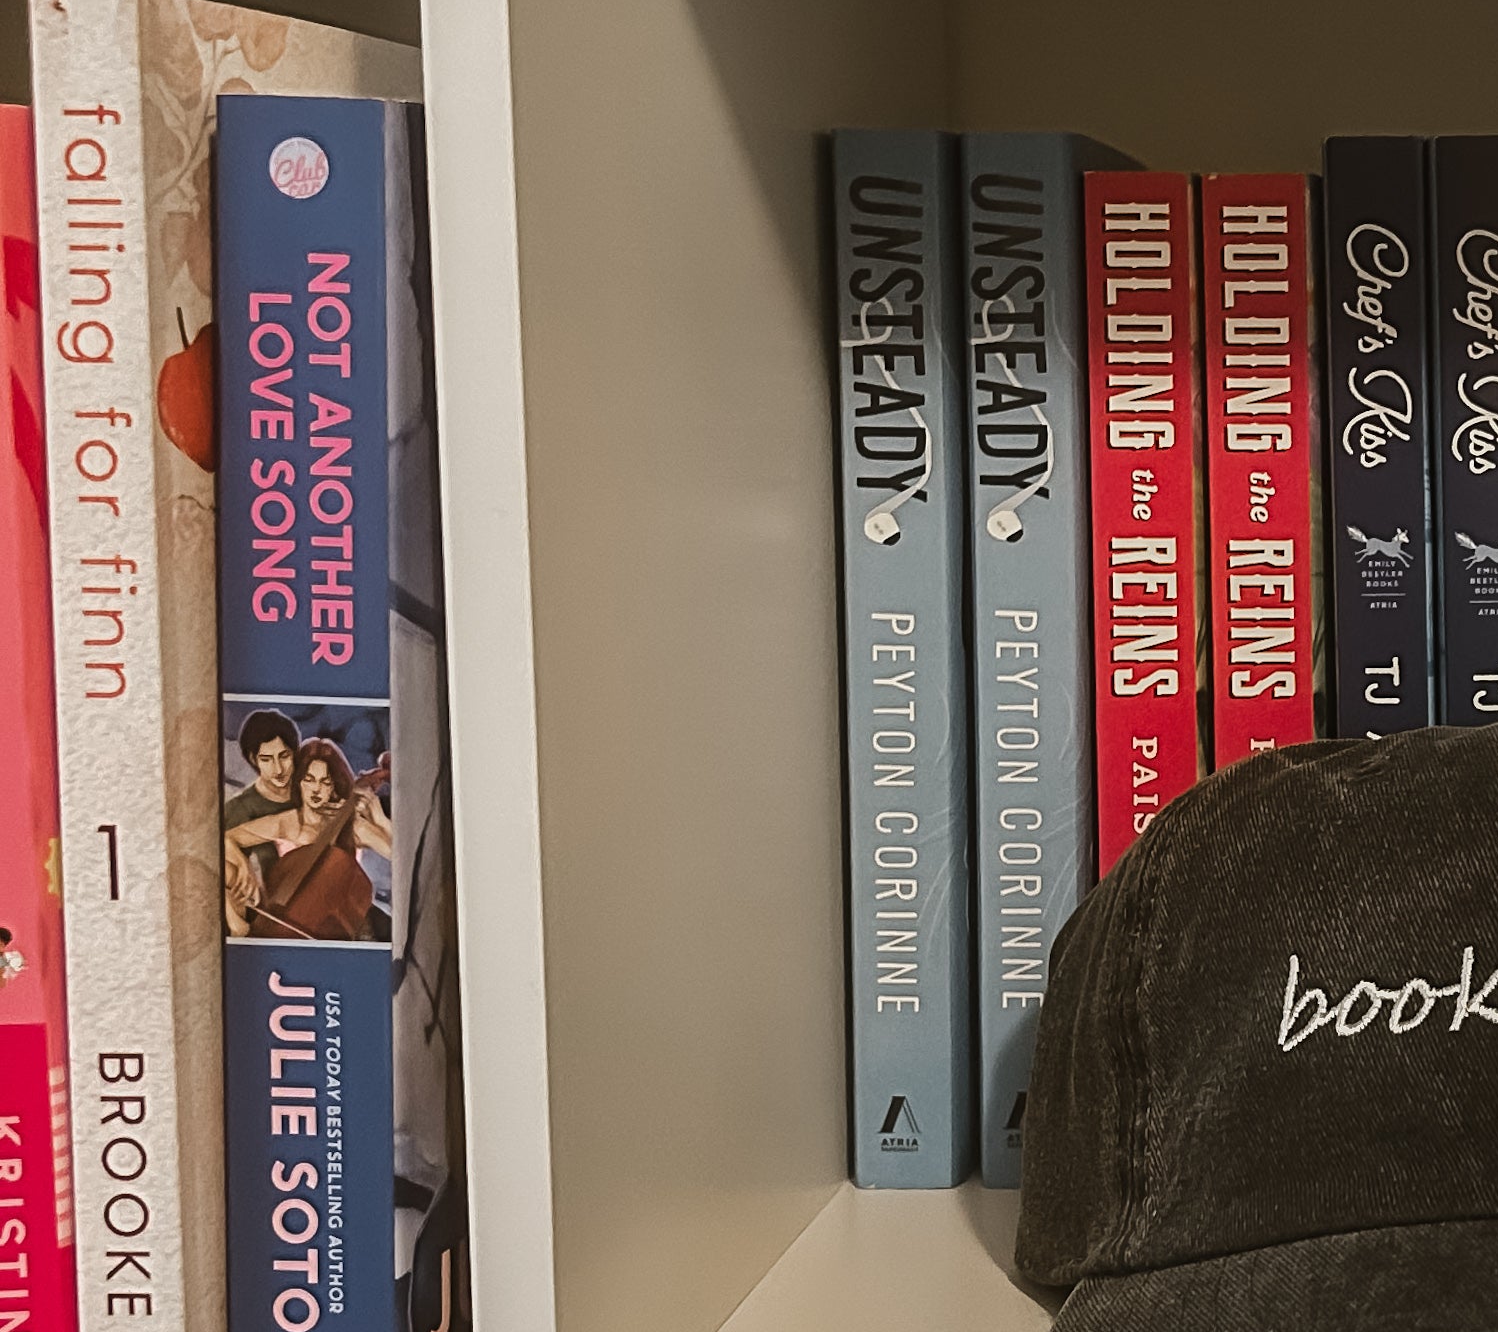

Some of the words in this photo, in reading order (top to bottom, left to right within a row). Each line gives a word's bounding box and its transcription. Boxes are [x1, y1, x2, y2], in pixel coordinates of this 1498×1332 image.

[57, 103, 125, 365] falling
[1343, 223, 1410, 353] Chef's
[248, 292, 295, 440] LOVE
[306, 252, 352, 379] NOT
[848, 175, 928, 503] UNSTEADY
[970, 173, 1051, 499] UNSTEADY
[1104, 202, 1175, 452] HOLDING
[1222, 205, 1293, 454] HOLDING
[75, 407, 132, 519] for
[1131, 469, 1152, 522] the
[1249, 471, 1277, 523] the
[1342, 366, 1413, 468] Kiss
[249, 458, 298, 624] SONG
[308, 406, 355, 666] ANOTHER
[80, 552, 138, 699] finn
[1110, 537, 1180, 697] REINS
[1229, 538, 1297, 699] REINS
[1364, 658, 1400, 705] TJ
[871, 612, 917, 788] PEYTON
[995, 610, 1039, 785] PEYTON
[874, 811, 920, 1014] CORINNE
[999, 808, 1044, 1009] CORINNE
[269, 971, 317, 1138] JULIE
[325, 991, 340, 1028] USA
[325, 1034, 341, 1099] TODAY
[99, 1052, 153, 1318] BROOKE
[326, 1105, 343, 1232] BESTSELLING
[327, 1237, 345, 1315] AUTHOR
